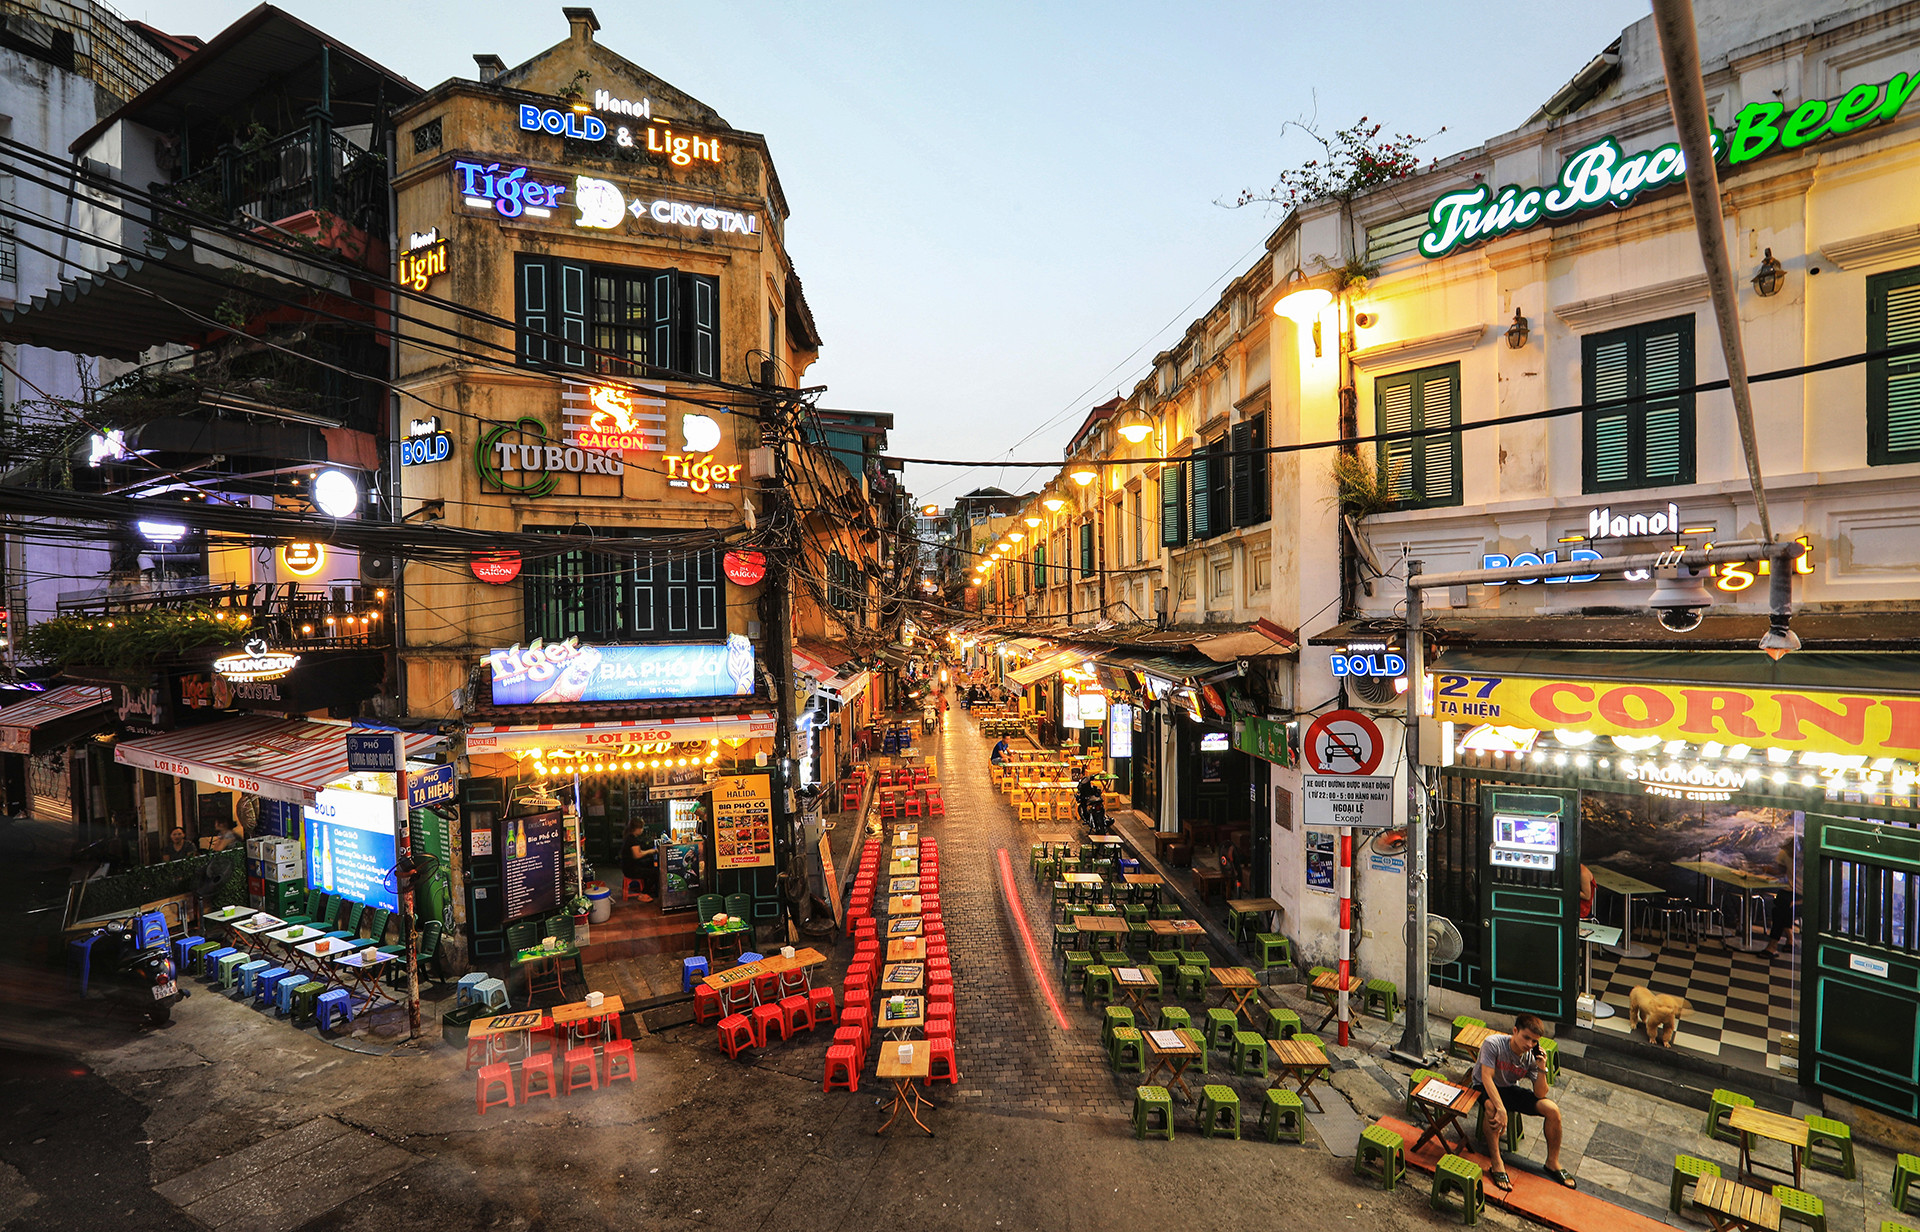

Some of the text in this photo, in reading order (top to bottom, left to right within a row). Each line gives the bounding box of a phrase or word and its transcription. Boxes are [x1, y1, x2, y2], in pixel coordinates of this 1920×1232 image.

[595, 88, 651, 120] Hanoi
[519, 103, 721, 166] BOLD & Light
[454, 160, 566, 218] Tiger
[1424, 134, 1720, 254] Trúc Bạc
[650, 199, 760, 236] CRYSTAL
[400, 245, 446, 291] Light
[602, 425, 621, 435] BIA
[401, 434, 449, 466] BOLD
[578, 433, 645, 450] SAIGON
[495, 442, 624, 476] TUBORG
[662, 453, 743, 493] Tiger
[1588, 501, 1680, 539] Hanoi
[730, 569, 758, 578] SAIGON
[1483, 549, 1604, 586] BOLD
[600, 663, 637, 680] BIA
[1330, 653, 1406, 677] BOLD
[236, 683, 281, 701] CRYSTAL
[1439, 676, 1502, 699] 27
[1440, 701, 1500, 719] TẠ HIỆN
[363, 739, 379, 749] PHỐ
[629, 728, 672, 743] BÉO
[172, 762, 190, 775] BÉO
[423, 770, 439, 784] PHỐ
[238, 777, 260, 792] BÉO
[414, 781, 449, 804] TẠ HIỆN
[1307, 780, 1313, 788] XE
[1315, 779, 1327, 789] QUÉT
[727, 790, 757, 798] HALIDA
[1645, 787, 1731, 801] APPLE CIDERS
[315, 802, 336, 817] BOLD
[1332, 803, 1364, 814] NGOẠI LỆ
[1334, 813, 1363, 824] Except
